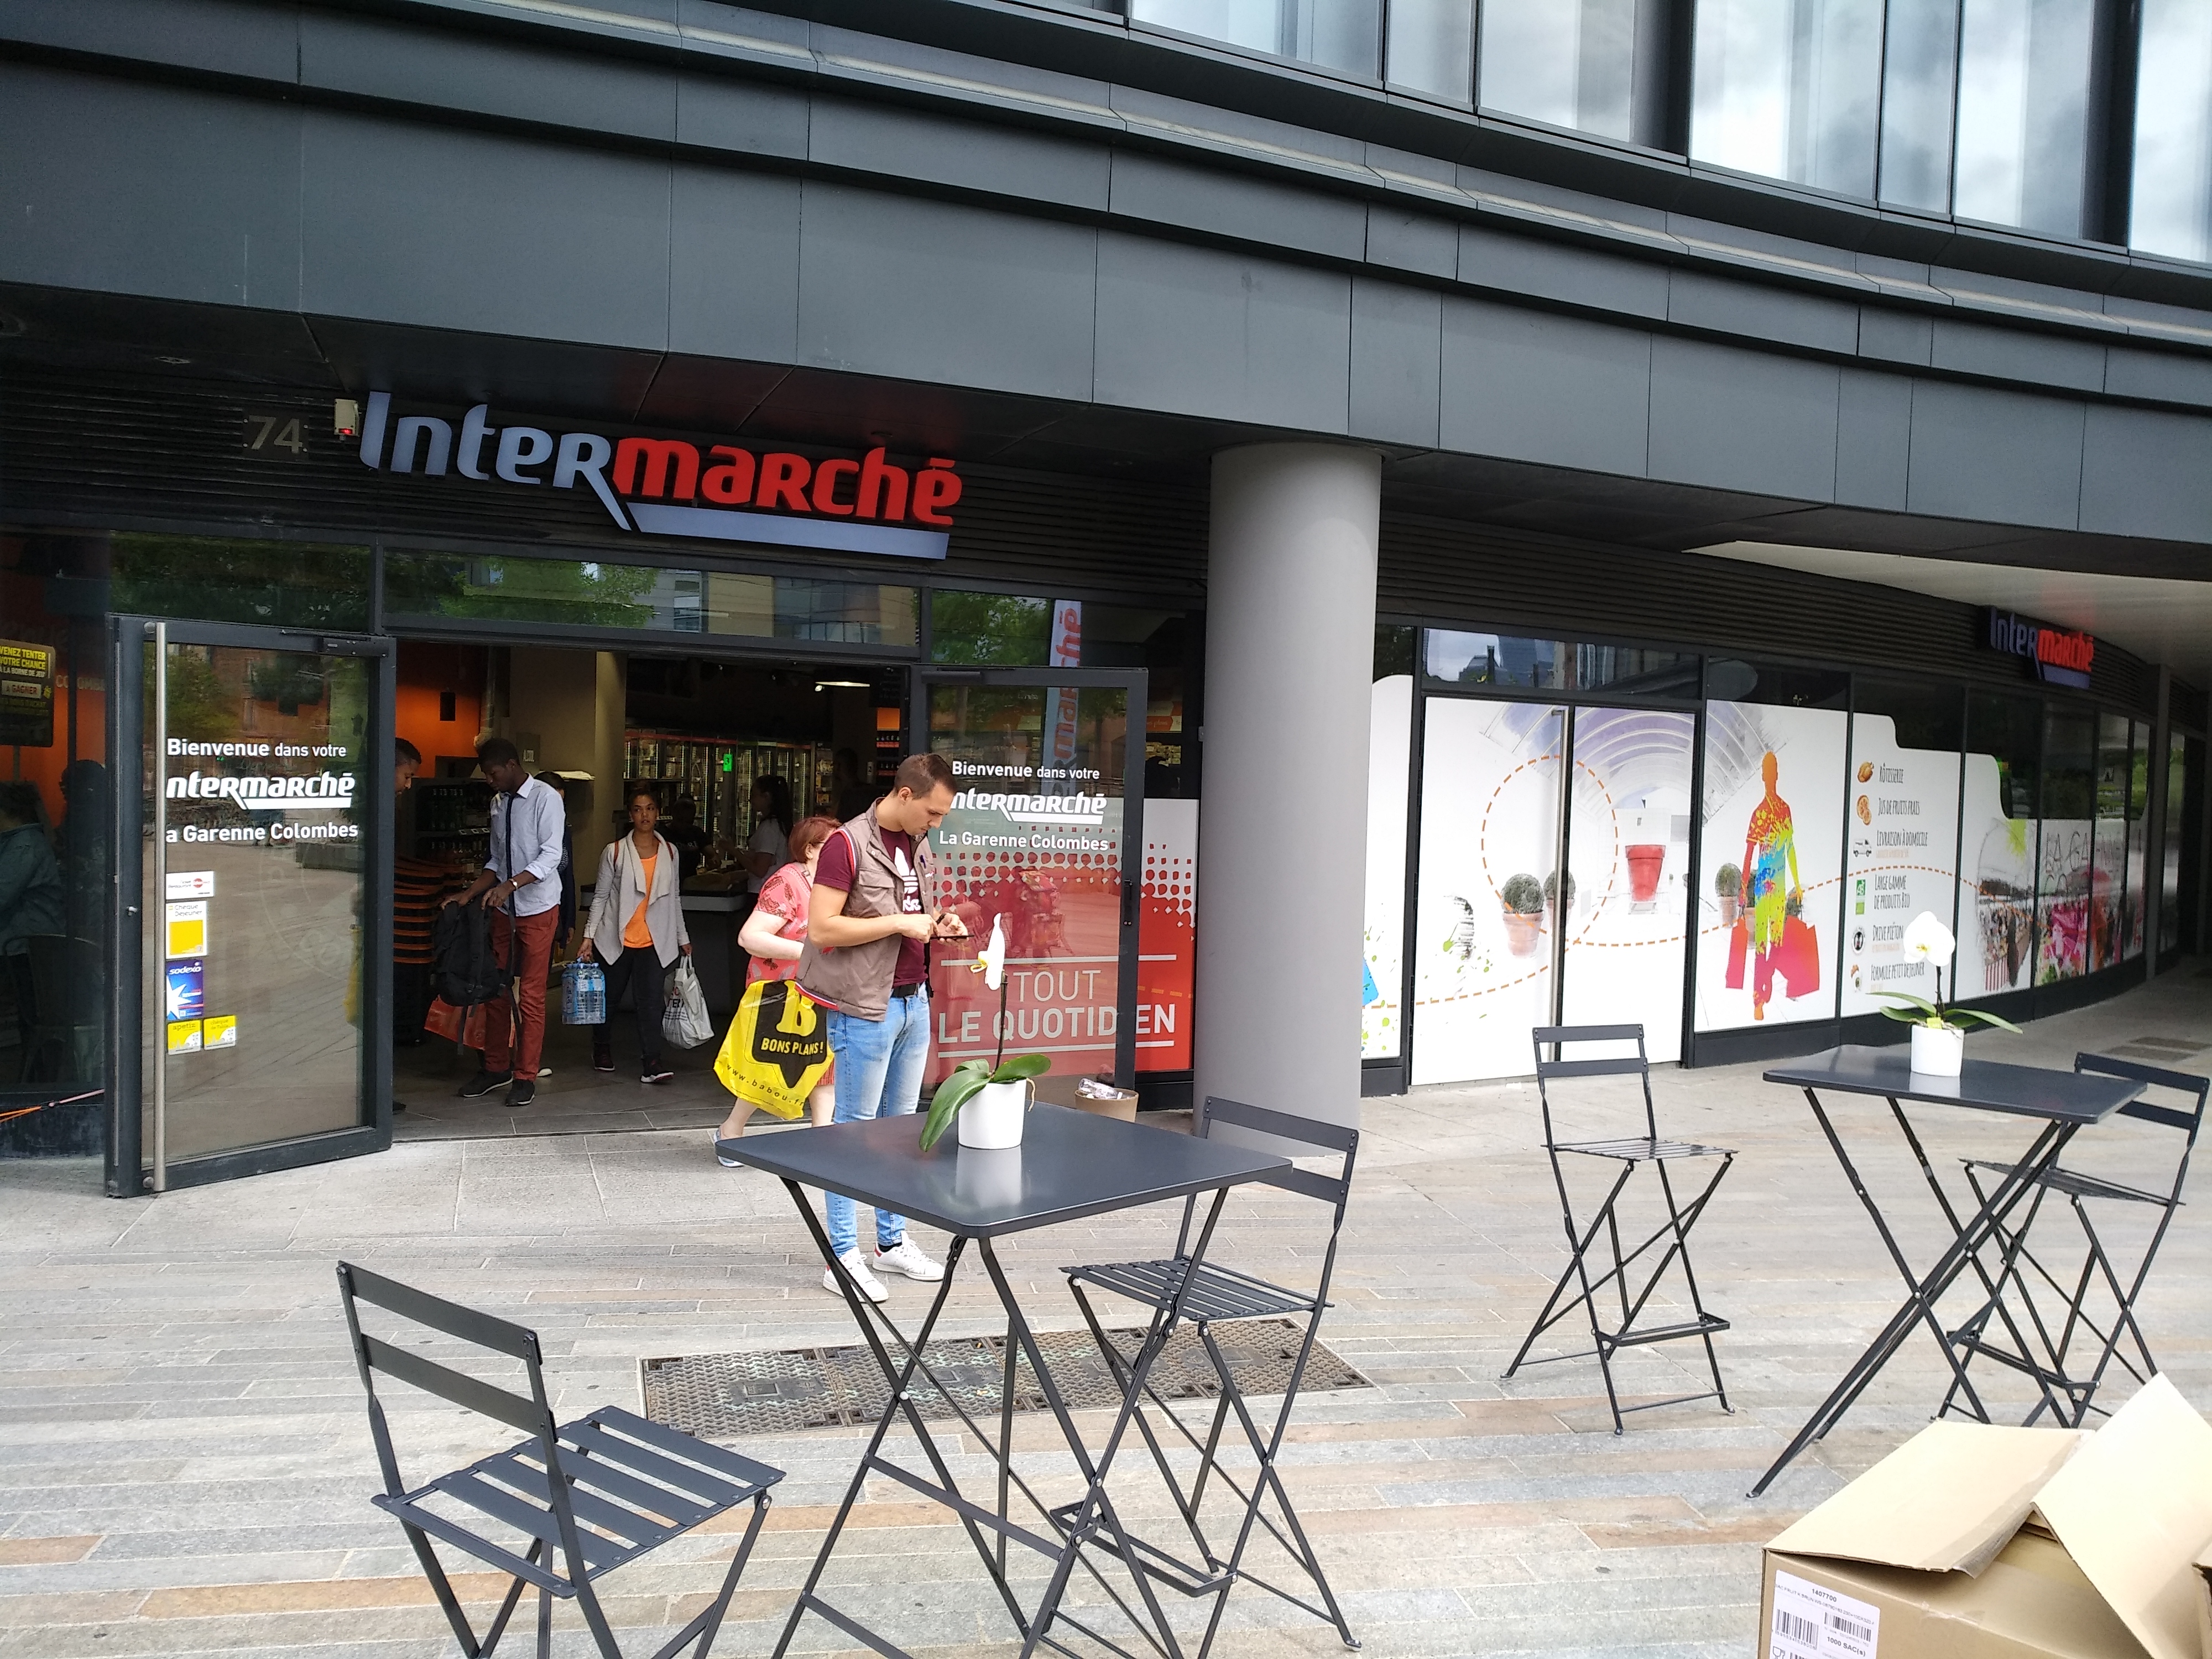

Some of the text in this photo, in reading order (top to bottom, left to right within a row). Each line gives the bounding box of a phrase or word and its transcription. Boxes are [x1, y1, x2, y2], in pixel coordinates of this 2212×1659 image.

[249, 415, 303, 454] 74
[22, 649, 46, 660] TENTER
[22, 660, 46, 670] CHANCE
[167, 738, 347, 757] Bienvenue dans votre
[952, 760, 1100, 779] Bienvenue dans votre
[166, 770, 356, 810] ntermarché
[950, 787, 1108, 822] ntermarché
[166, 822, 358, 843] a Garenne Colombes
[940, 830, 1109, 851] La Garenne Colombes
[169, 966, 202, 975] sodexo
[1013, 970, 1102, 1003] TOUT
[173, 1022, 196, 1031] apetiz
[938, 1004, 1175, 1044] LE QUOTIDEN
[760, 1037, 790, 1054] BONS
[726, 1063, 805, 1107] www.babou.fr
[1812, 1588, 1837, 1603] 1407700
[1827, 1636, 1841, 1646] 1000
[1843, 1642, 1866, 1657] SAC(s)
